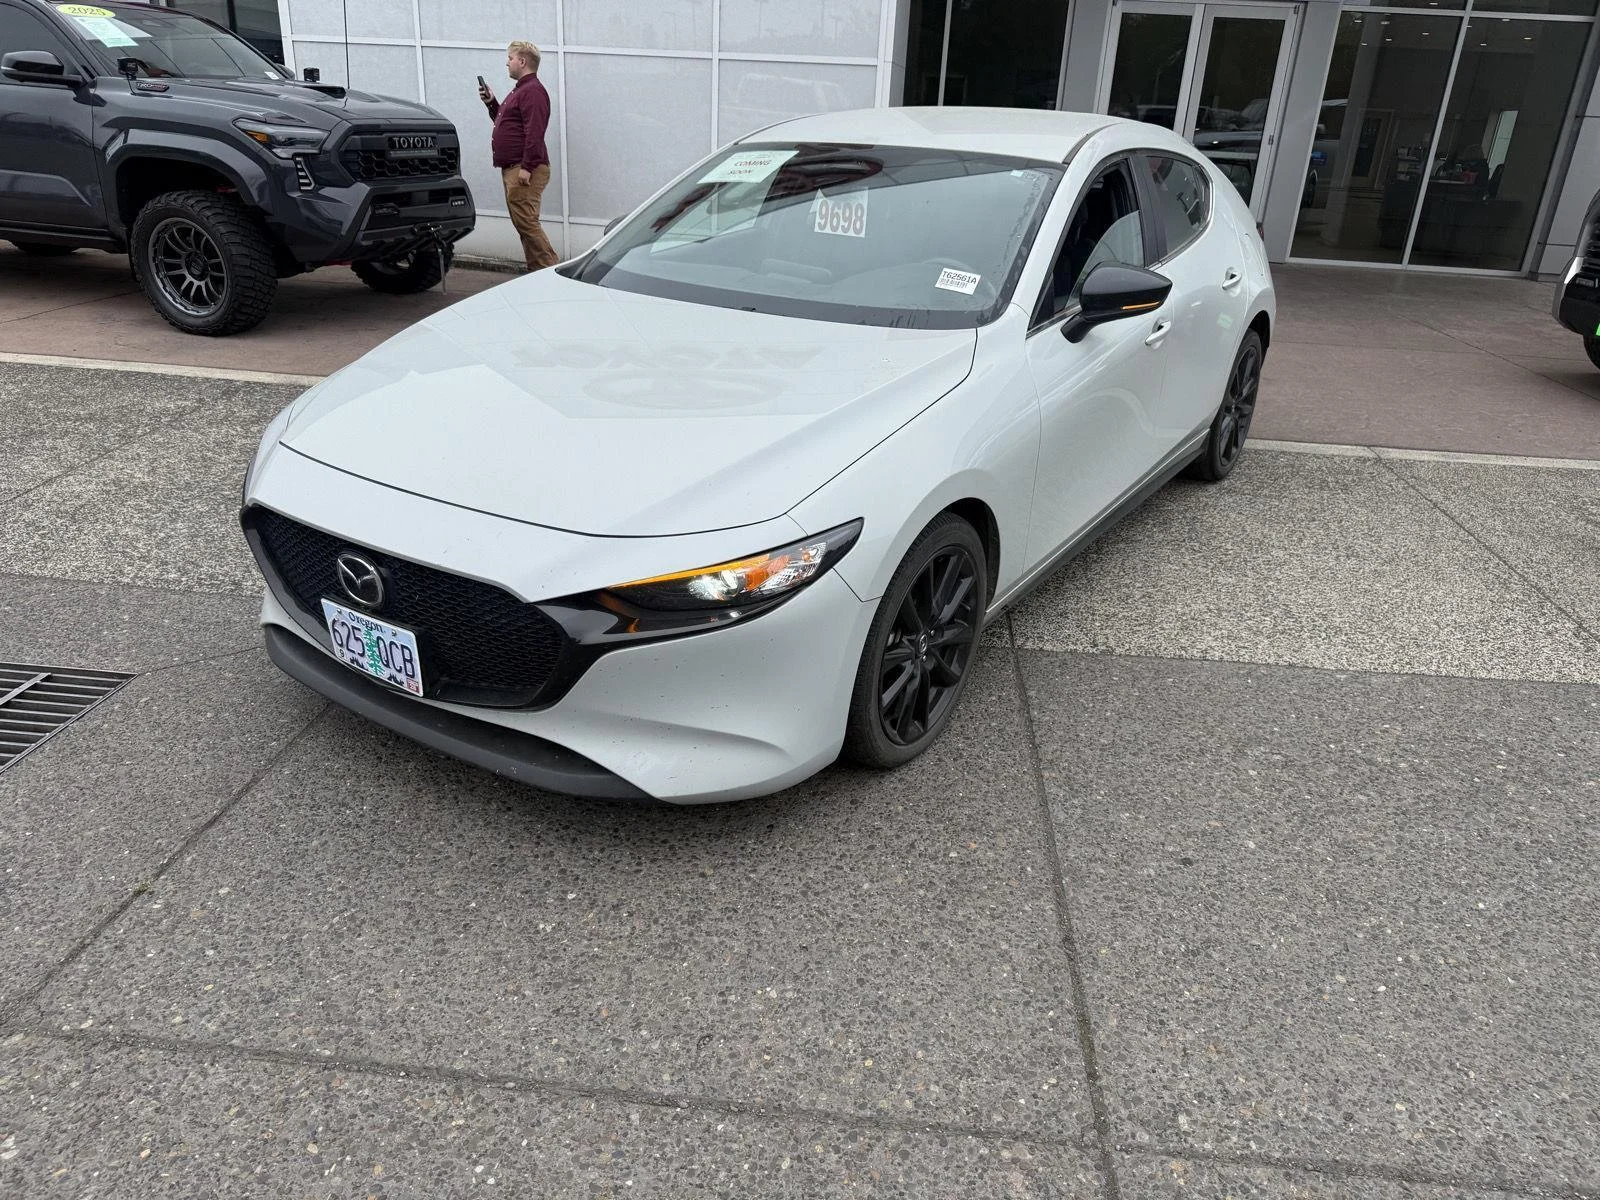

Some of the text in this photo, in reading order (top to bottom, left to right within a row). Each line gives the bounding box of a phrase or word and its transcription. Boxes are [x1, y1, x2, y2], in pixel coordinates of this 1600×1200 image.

[67, 6, 106, 16] 2025
[392, 136, 435, 149] TOYOTA
[734, 159, 772, 167] COMING
[817, 199, 865, 236] 9698
[348, 611, 384, 634] Oregon
[331, 617, 416, 679] 625 QCB
